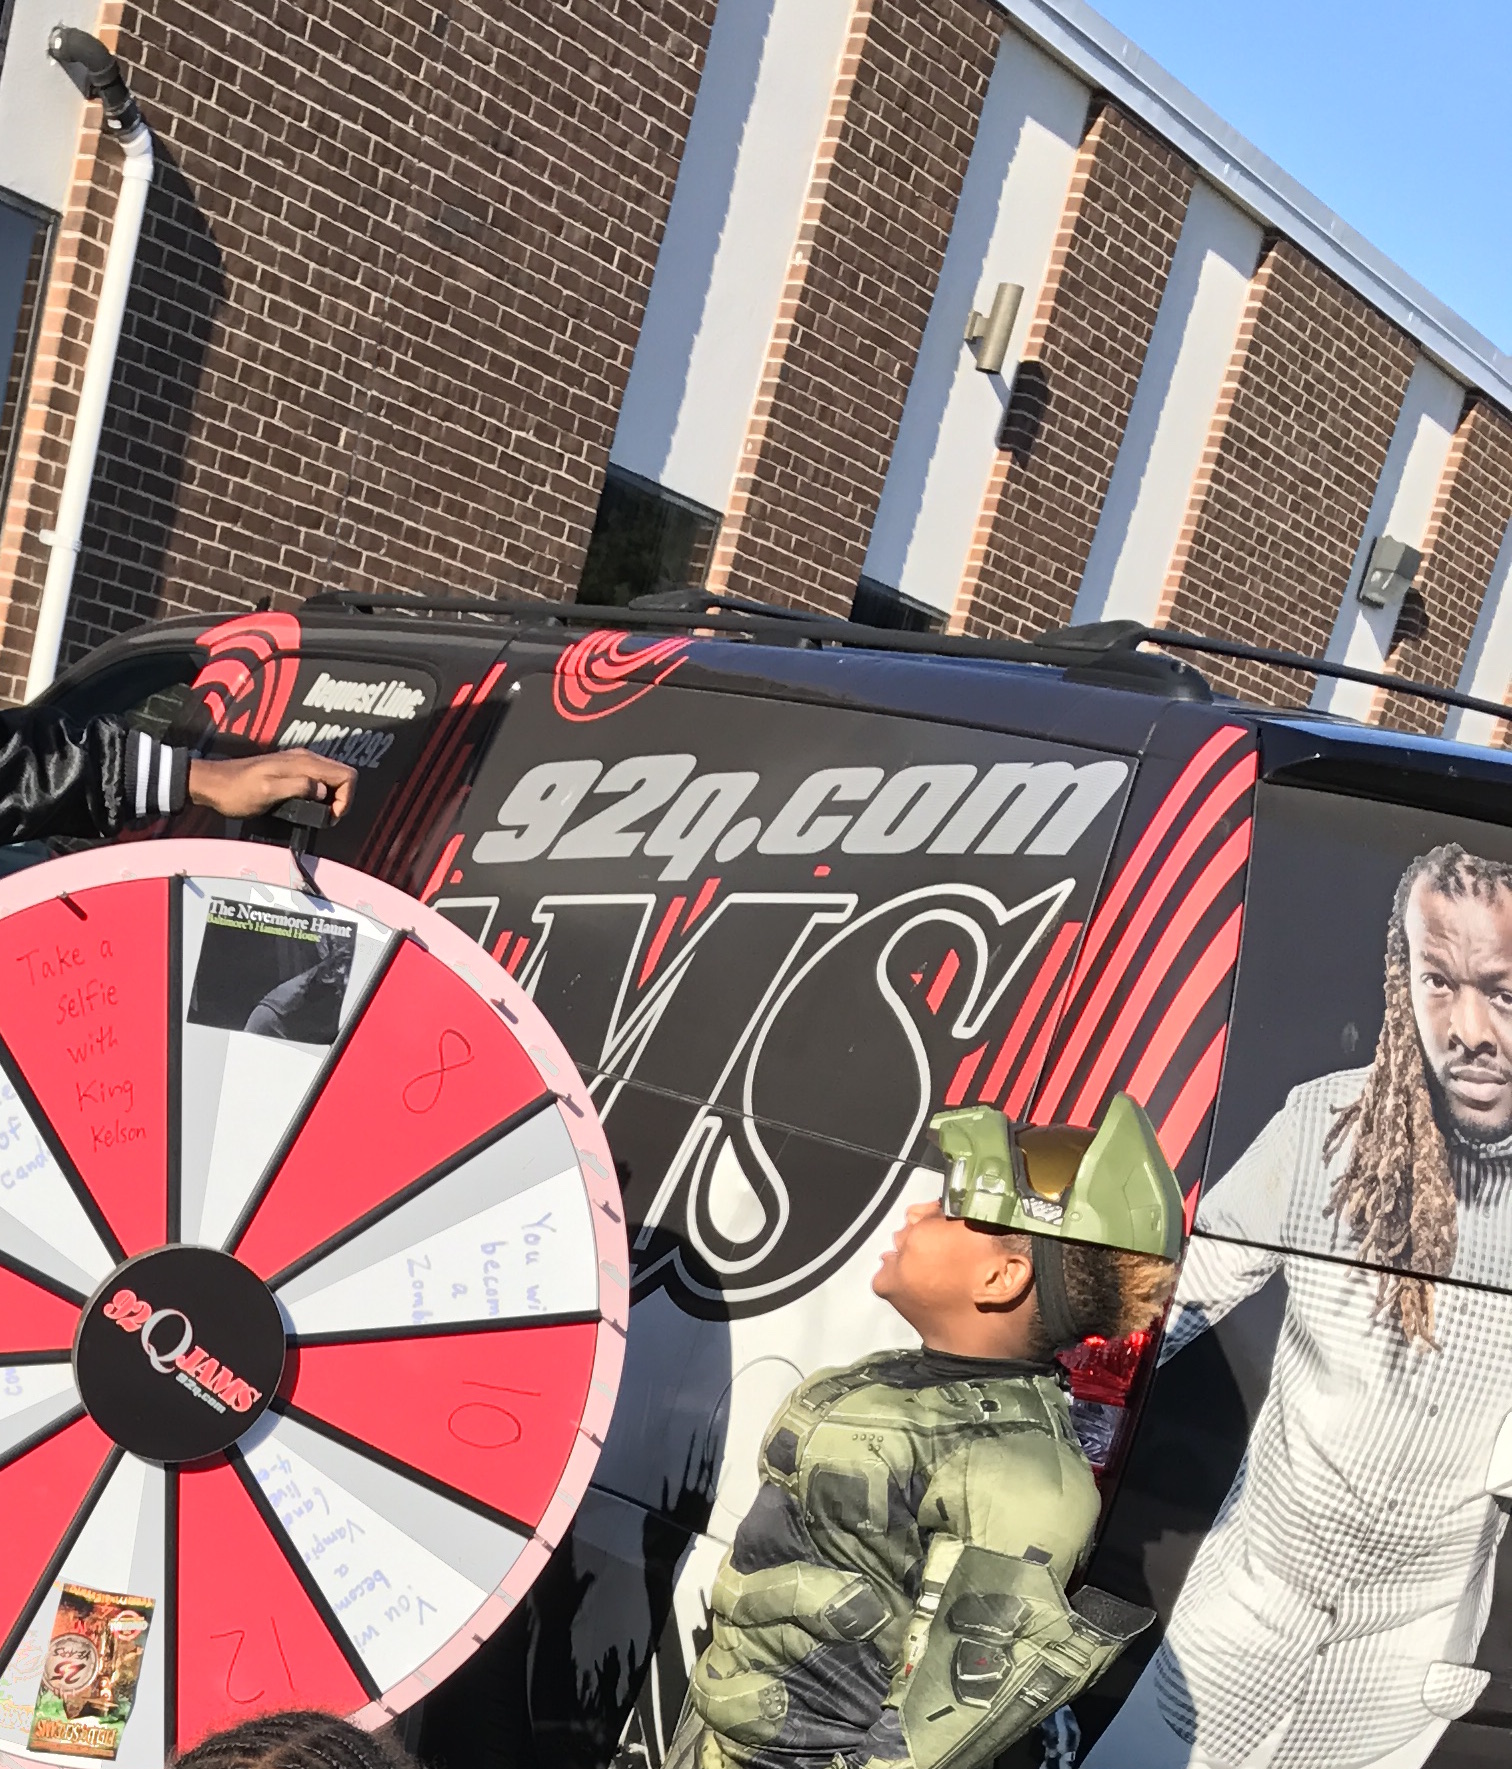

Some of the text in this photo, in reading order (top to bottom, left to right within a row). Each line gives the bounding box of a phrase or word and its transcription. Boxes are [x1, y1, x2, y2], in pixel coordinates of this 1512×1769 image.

[302, 672, 387, 714] Request
[472, 753, 1129, 882] 92q.com
[207, 913, 321, 943] Baltimore's Haunted House
[209, 899, 353, 938] The Nevermore Haunt
[16, 939, 114, 986] Take a
[56, 978, 119, 1025] selfie
[66, 1026, 119, 1064] with
[402, 1028, 475, 1114] 8
[76, 1079, 134, 1113] King
[90, 1119, 147, 1153] Kelson
[0, 1134, 51, 1190] cand
[480, 1241, 508, 1316] becom
[521, 1212, 557, 1312] You wi
[452, 1282, 468, 1299] a
[175, 1345, 262, 1413] JAMS
[175, 1372, 227, 1415] 92q.com
[447, 1380, 542, 1450] 10
[304, 1518, 366, 1564] Vampir
[334, 1563, 349, 1579] a
[334, 1569, 392, 1615] becom
[353, 1585, 438, 1654] You wi
[51, 1660, 86, 1685] 25
[53, 1647, 92, 1661] YEARS
[210, 1616, 296, 1704] 12
[34, 1719, 82, 1743] SCREAMS
[87, 1726, 117, 1747] FIELD
